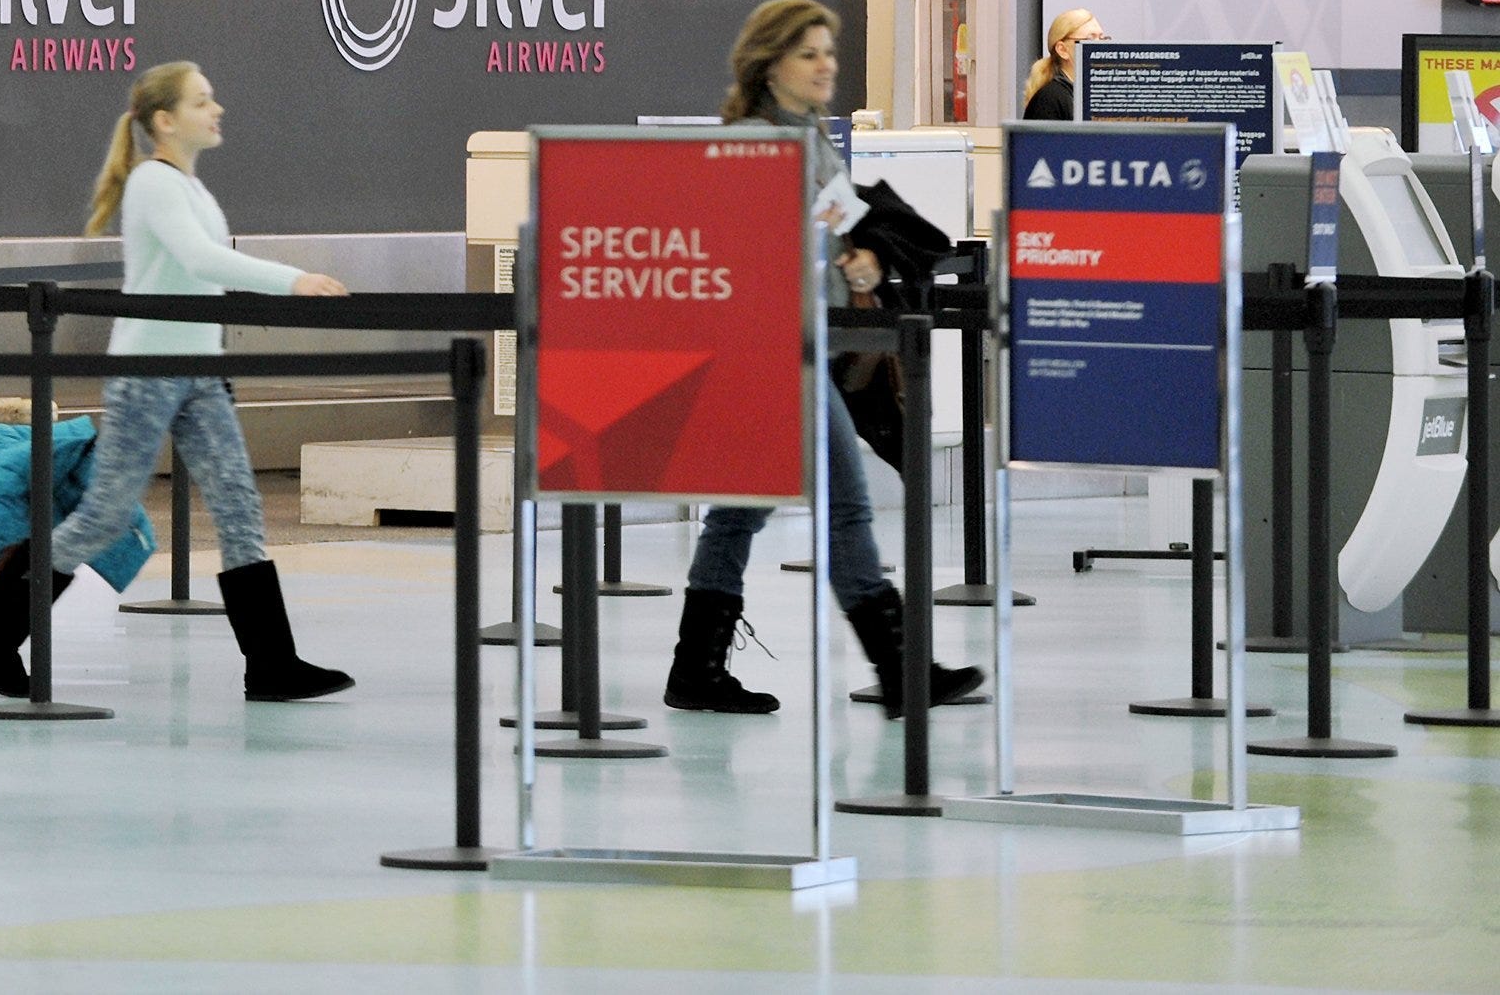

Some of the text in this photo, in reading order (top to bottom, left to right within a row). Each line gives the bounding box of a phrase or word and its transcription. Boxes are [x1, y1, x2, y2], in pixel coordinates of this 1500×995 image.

[11, 37, 136, 71] AIRWAYS
[487, 40, 606, 73] AIRWAYS
[1090, 51, 1180, 59] ADVICE TO PASSENGERS
[1425, 58, 1475, 70] THESE
[1062, 158, 1173, 188] DELTA
[560, 226, 710, 260] SPECIAL
[1016, 231, 1055, 247] SKY
[1016, 248, 1104, 266] PRIORITY
[560, 266, 733, 300] SERVICES
[1421, 415, 1455, 444] jetBlue
